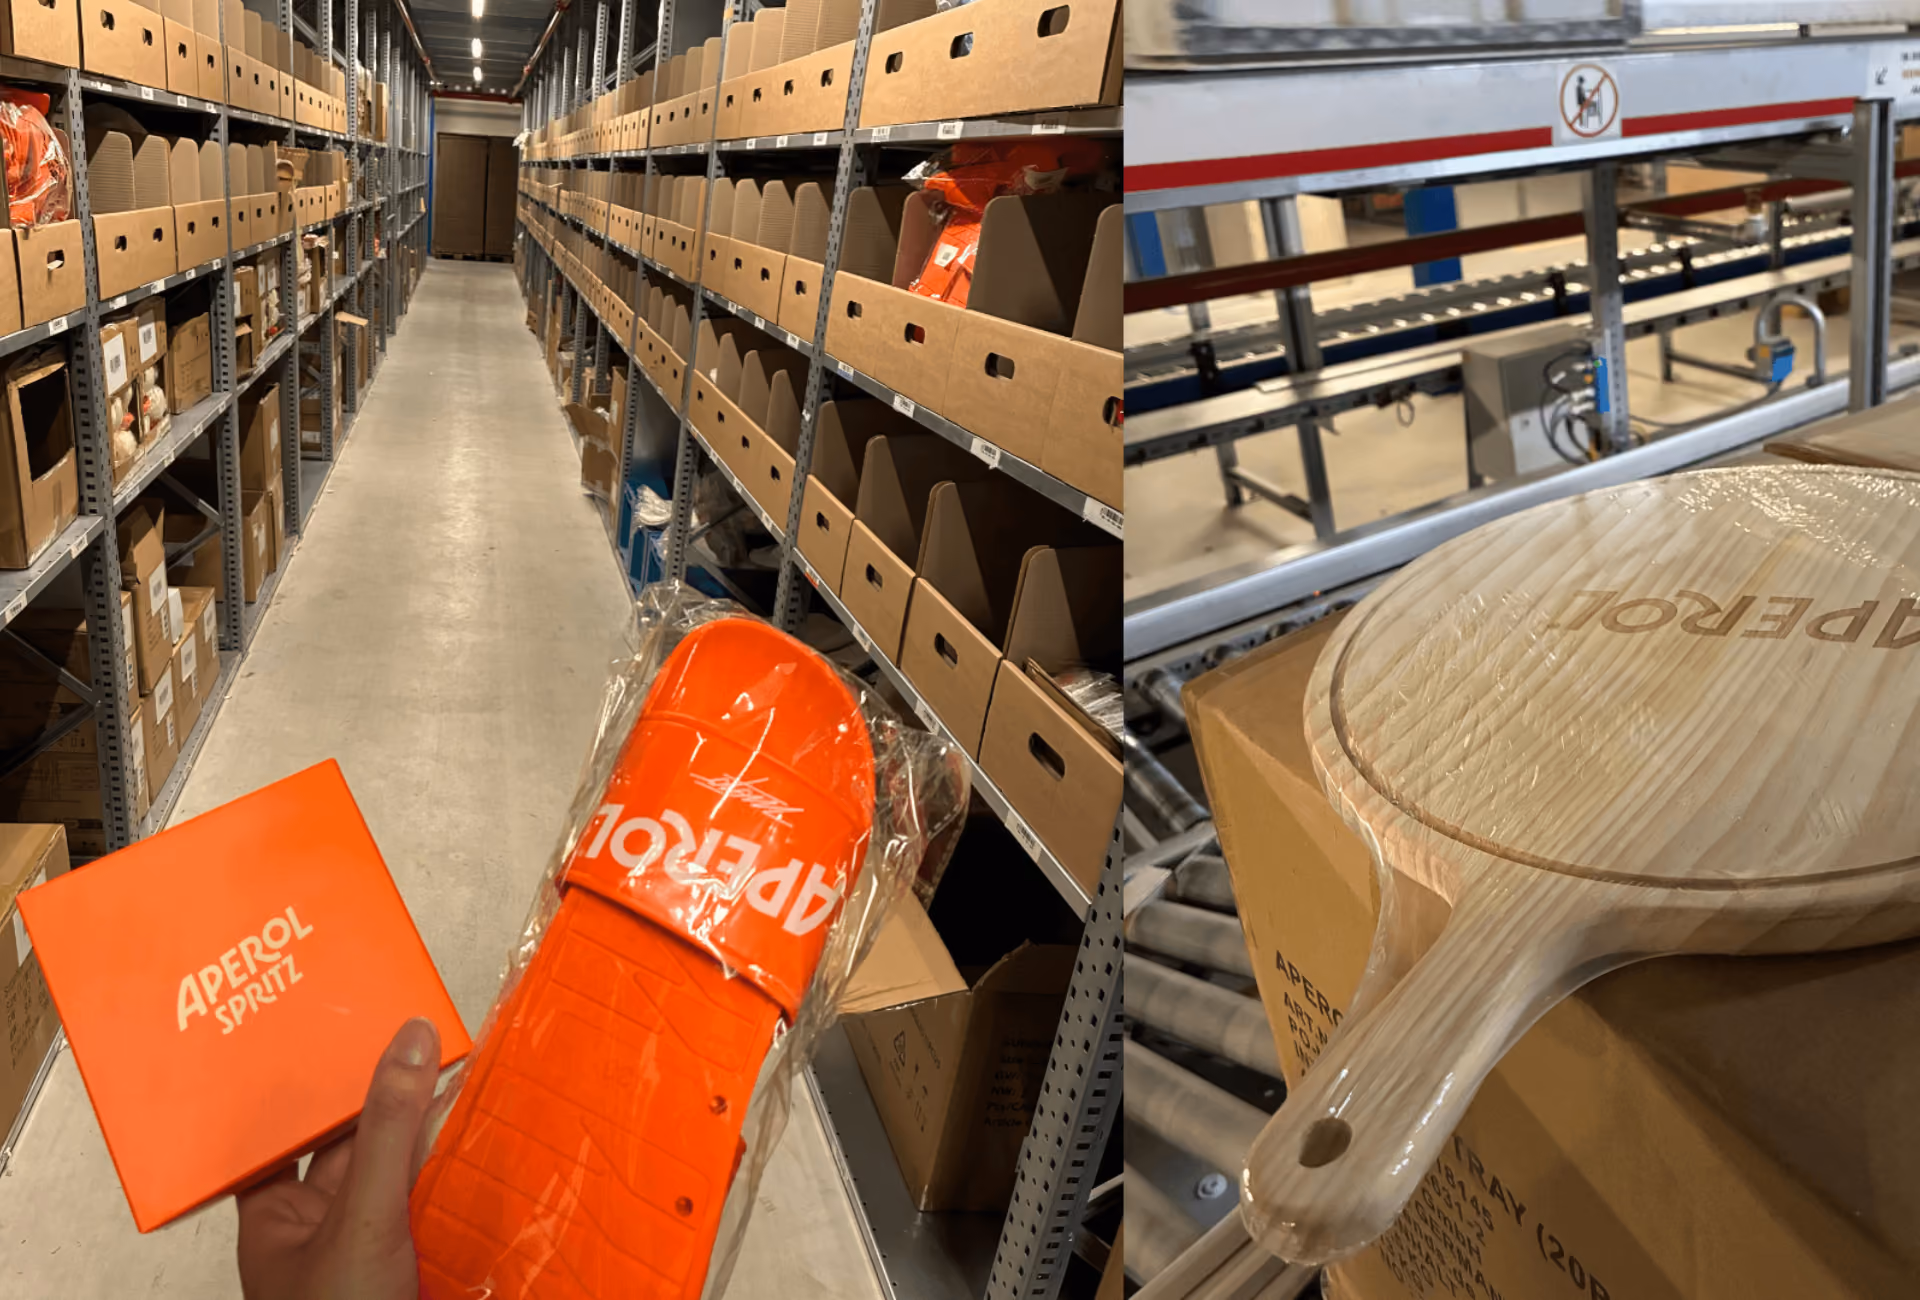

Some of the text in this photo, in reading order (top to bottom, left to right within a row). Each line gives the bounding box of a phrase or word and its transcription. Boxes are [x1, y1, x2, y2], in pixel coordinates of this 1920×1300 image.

[1546, 589, 1920, 648] APEROL
[578, 802, 848, 936] APEROL
[177, 905, 314, 1032] APEROL
[214, 954, 304, 1035] SPRITZ
[1453, 1136, 1527, 1226] TRAY
